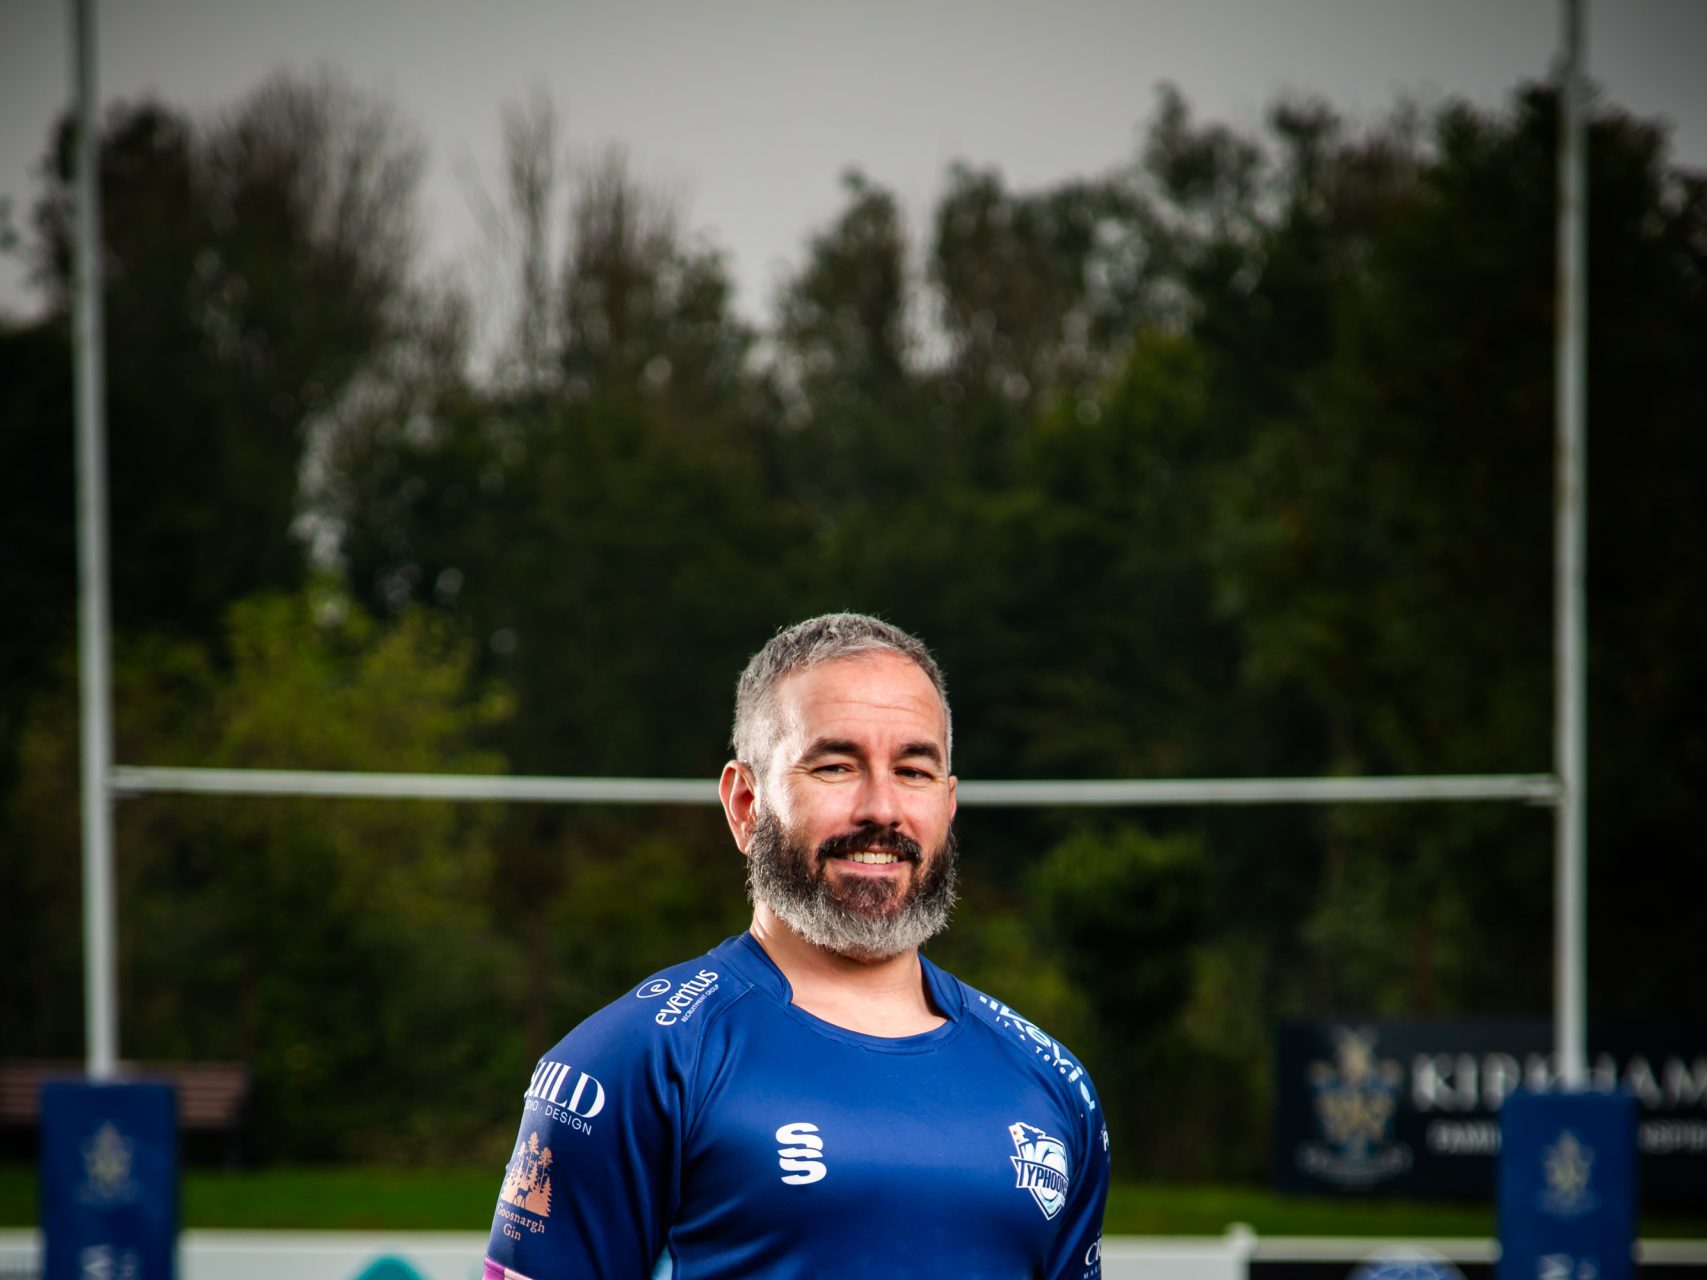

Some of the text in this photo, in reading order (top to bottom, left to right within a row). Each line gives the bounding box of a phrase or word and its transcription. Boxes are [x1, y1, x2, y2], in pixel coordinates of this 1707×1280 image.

[655, 969, 719, 1026] eventus
[524, 1058, 606, 1118] UILD
[545, 1105, 593, 1136] DESIGN
[497, 1202, 546, 1234] Goosnargh
[503, 1223, 521, 1241] Gin
